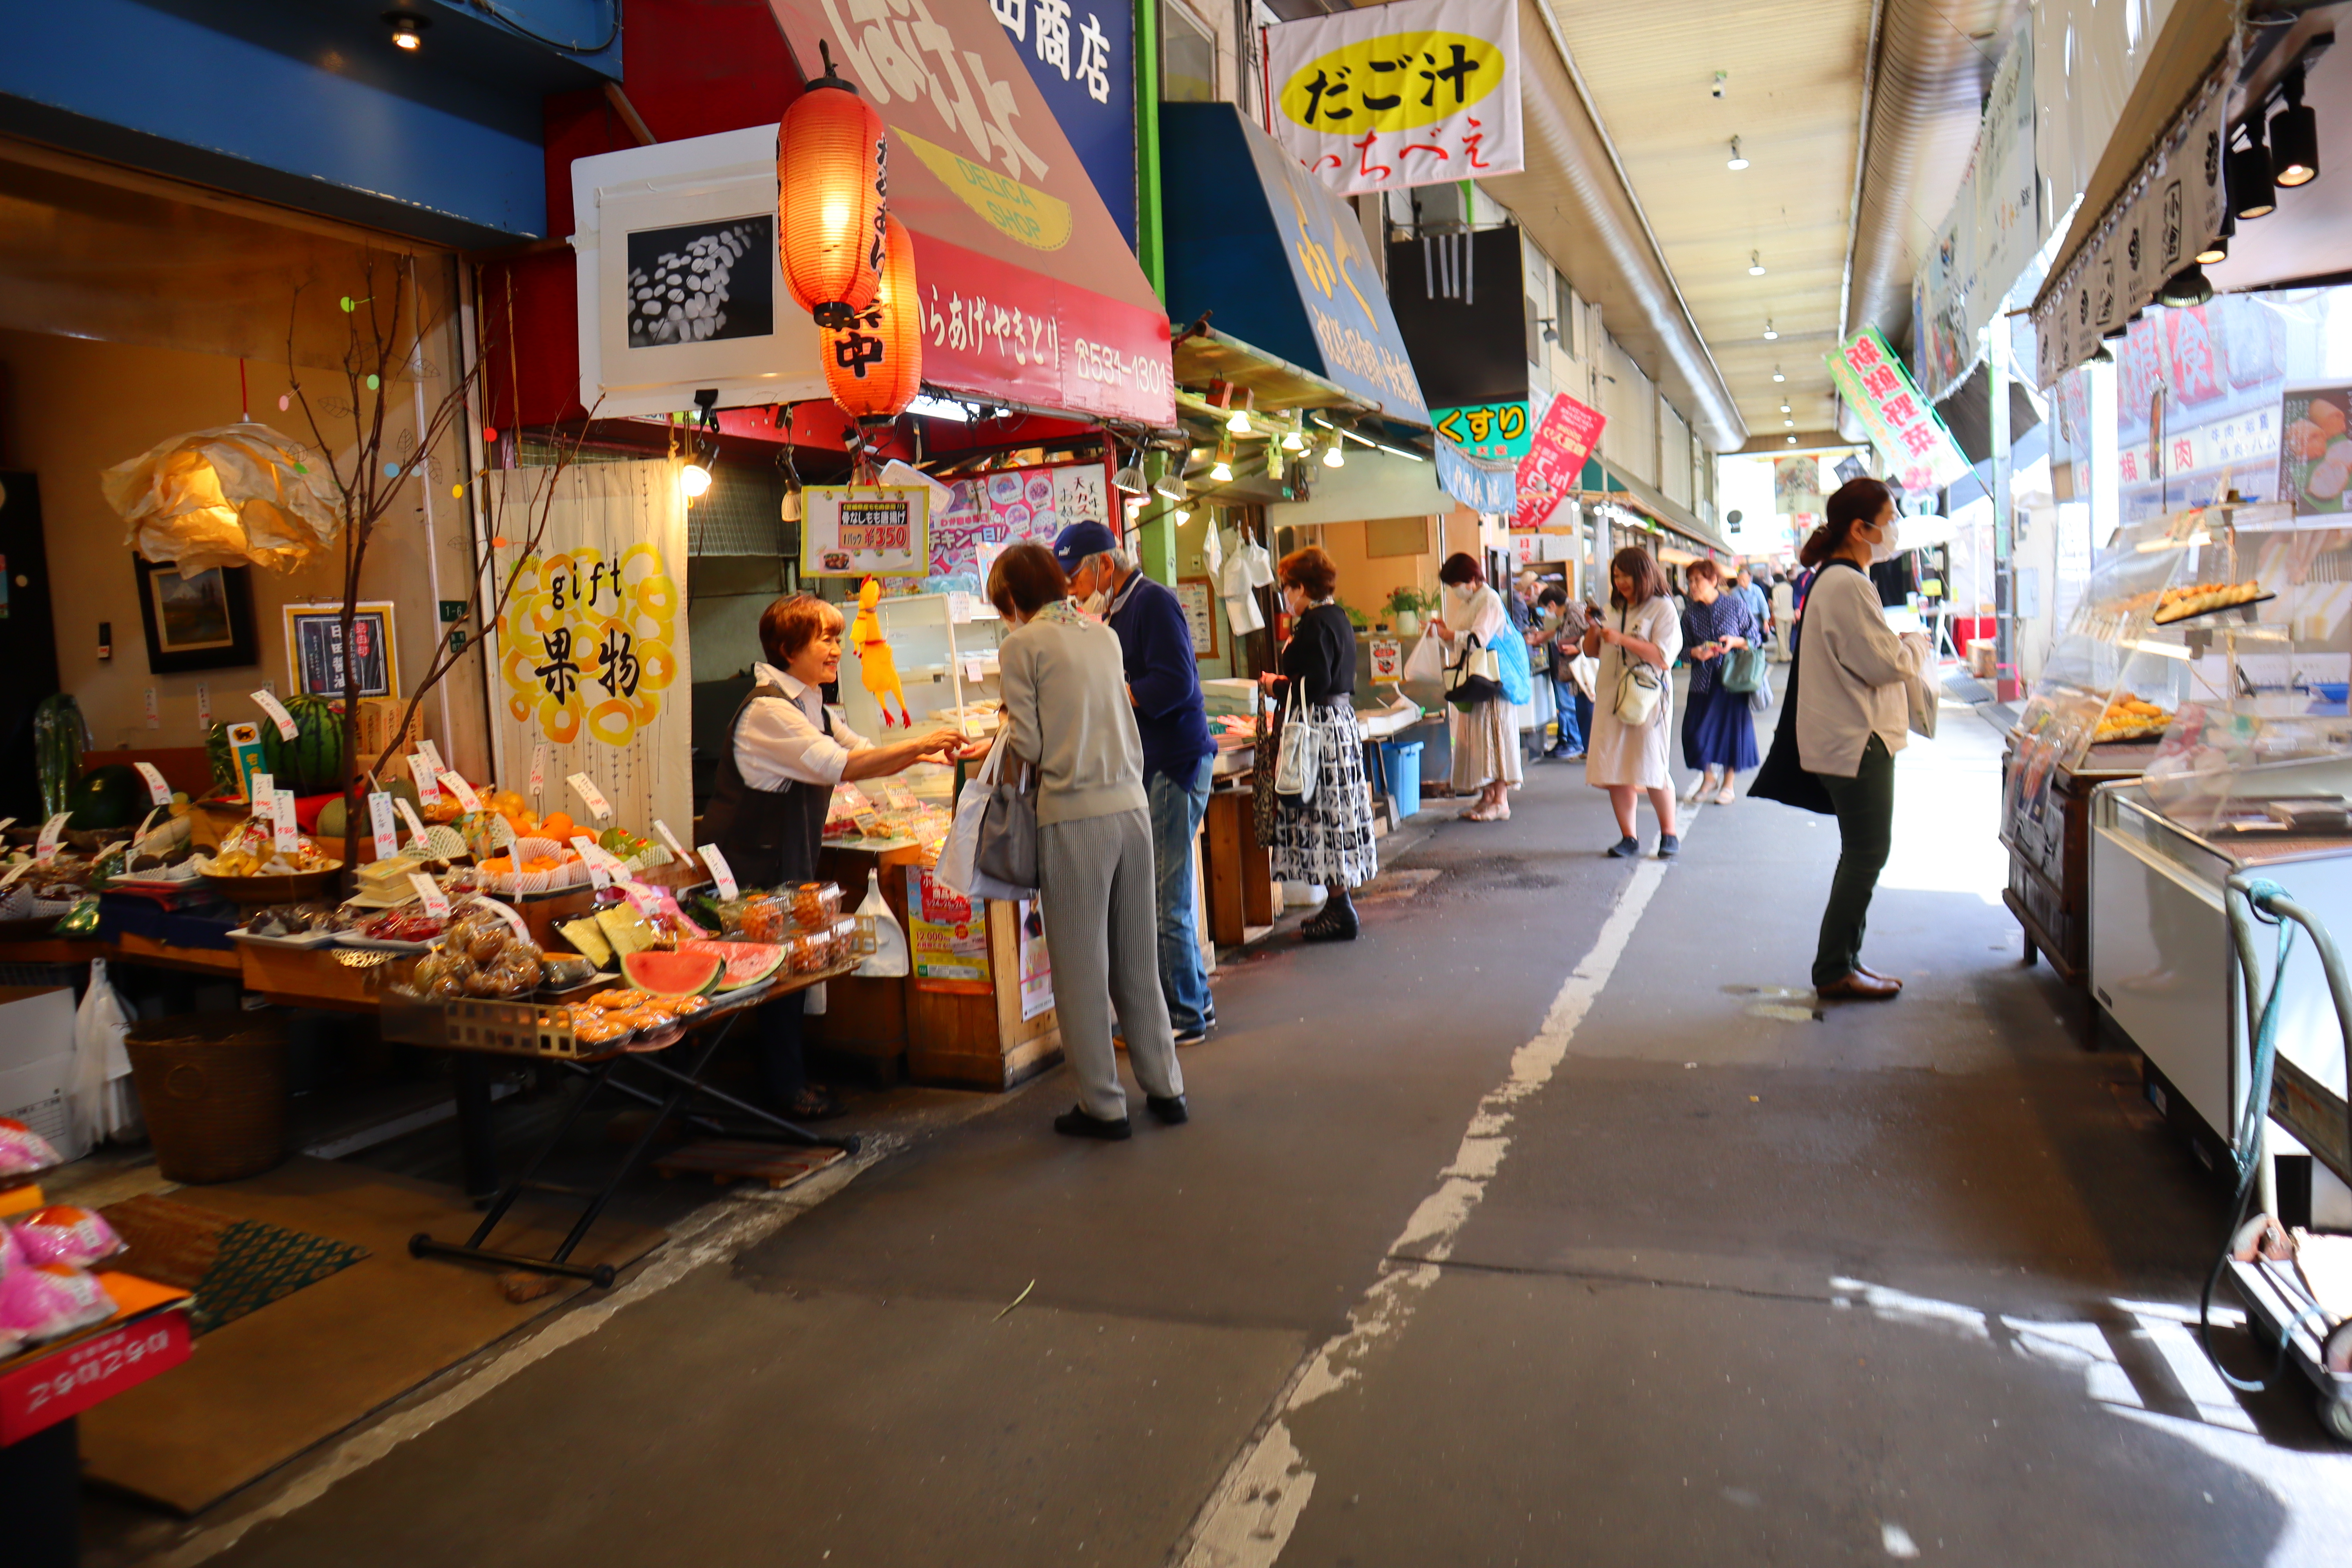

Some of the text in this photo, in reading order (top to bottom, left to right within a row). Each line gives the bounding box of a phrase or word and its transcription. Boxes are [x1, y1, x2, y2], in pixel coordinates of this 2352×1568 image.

[1304, 45, 1480, 124] だご汁
[954, 157, 1037, 211] DELICA
[985, 200, 1041, 241] SHOP
[918, 283, 1060, 371] らあげ・やきとり
[1438, 405, 1526, 443] くすり
[842, 511, 906, 525] 骨なしもも唐揚げ
[865, 526, 906, 547] ¥350
[552, 557, 621, 610] gift
[446, 606, 462, 617] 1-6
[535, 627, 640, 705] 果物
